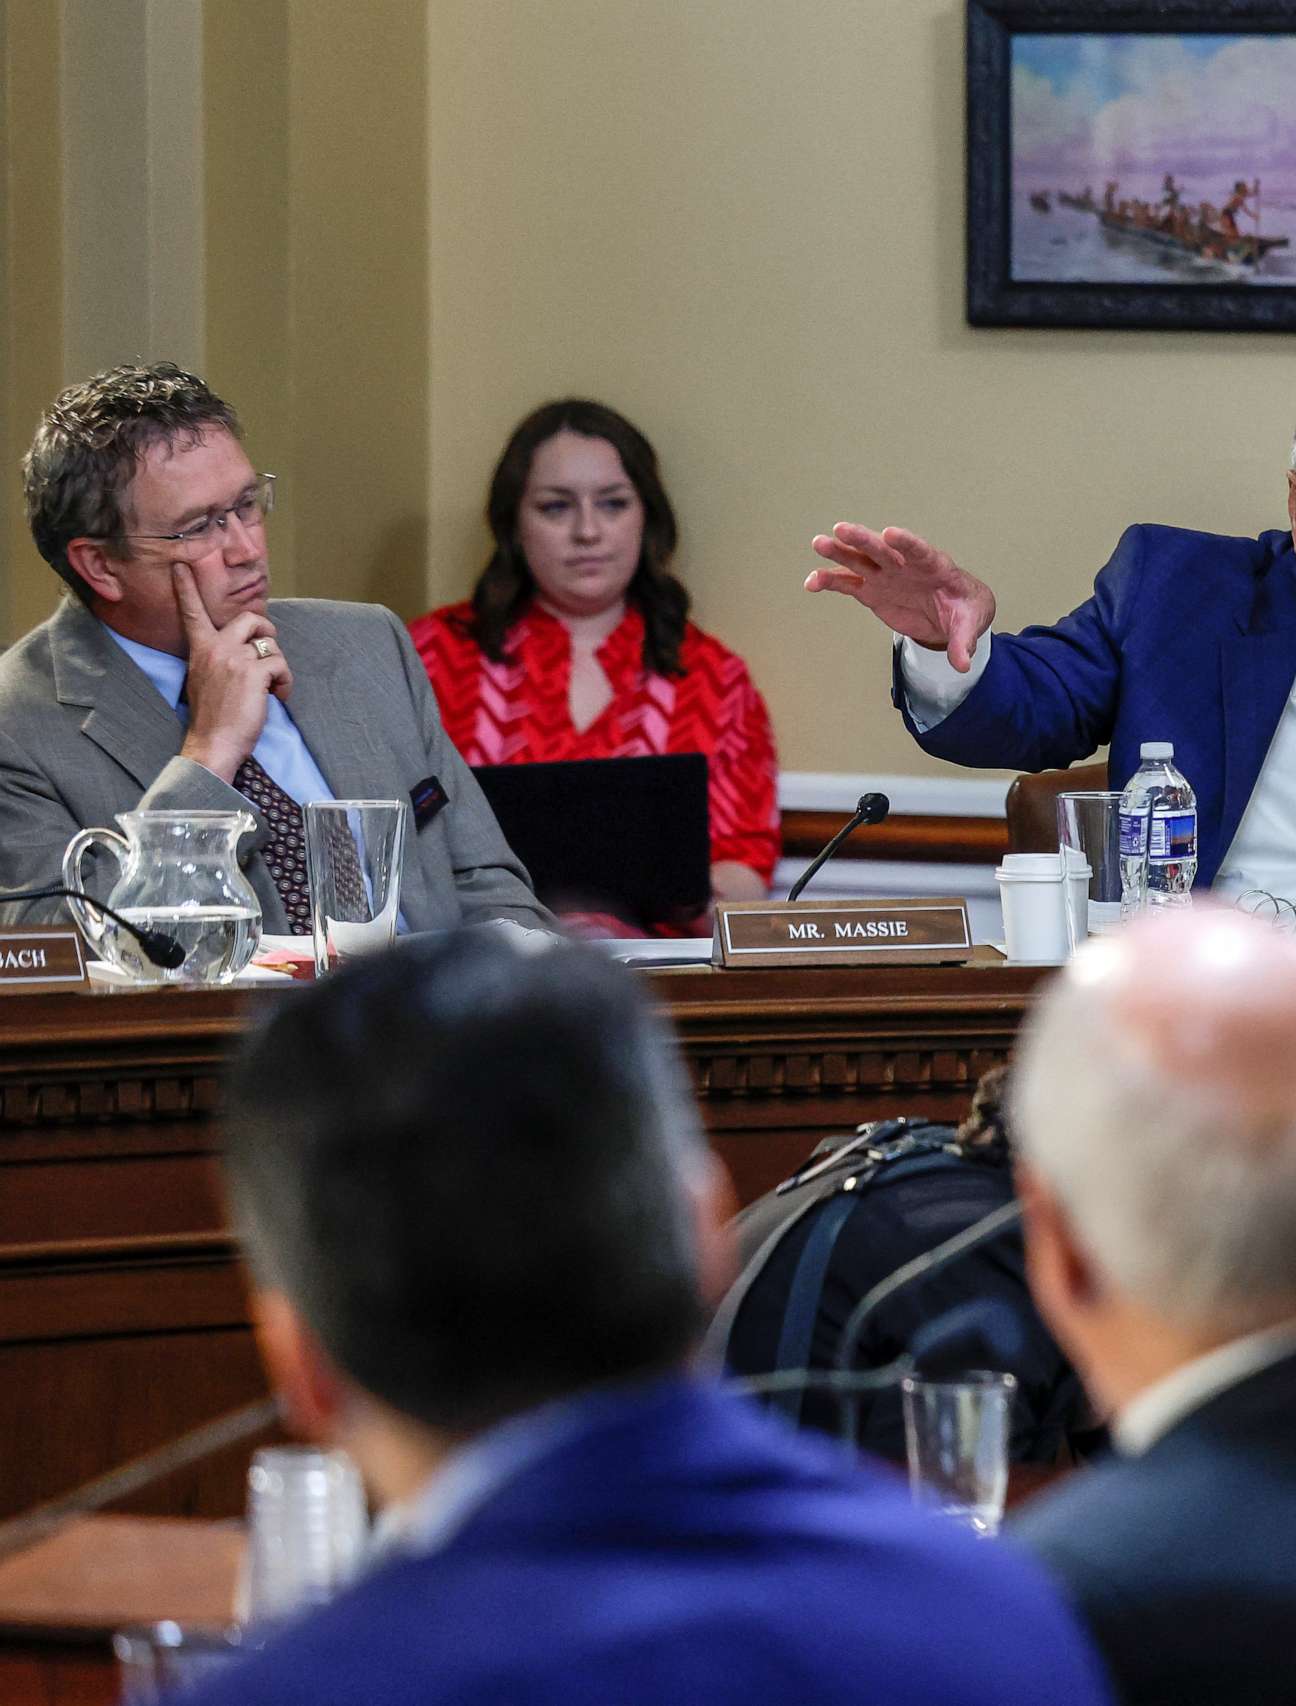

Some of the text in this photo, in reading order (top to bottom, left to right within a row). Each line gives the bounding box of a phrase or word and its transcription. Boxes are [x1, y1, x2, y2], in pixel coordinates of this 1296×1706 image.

[788, 921, 909, 939] MR. MASSIE
[0, 949, 47, 969] ACH
